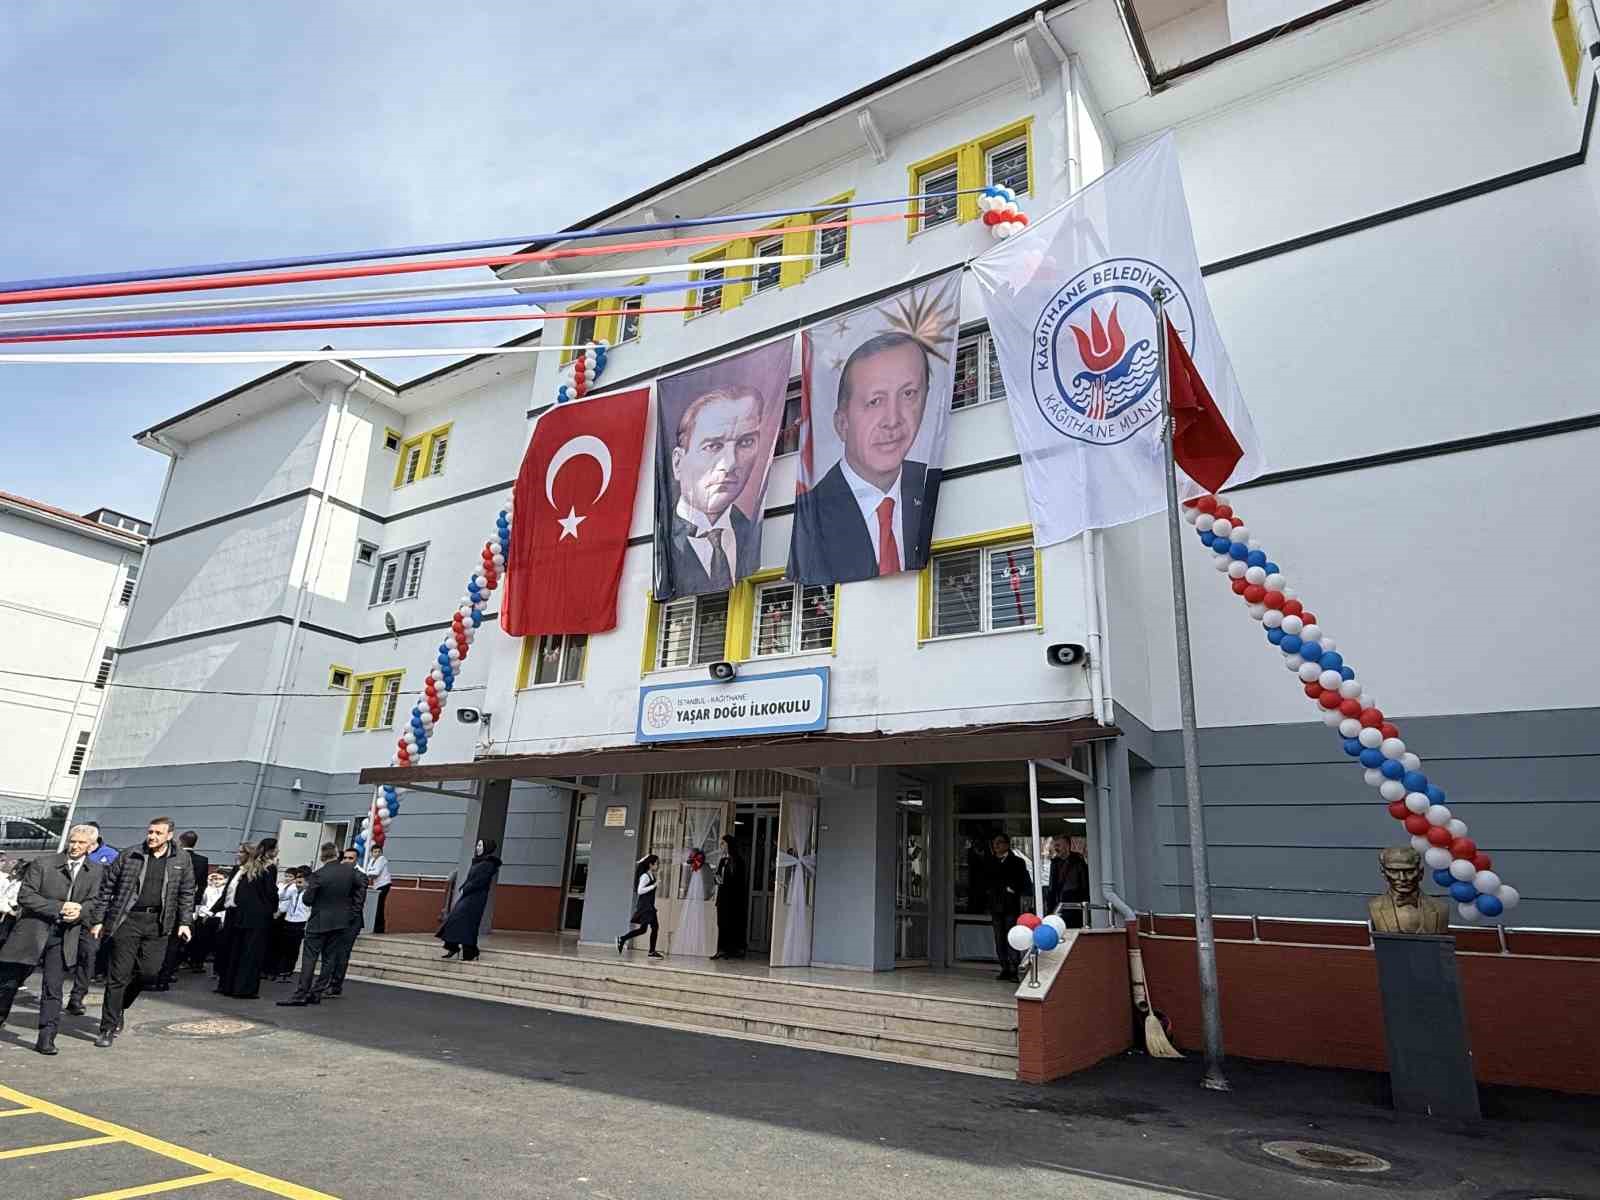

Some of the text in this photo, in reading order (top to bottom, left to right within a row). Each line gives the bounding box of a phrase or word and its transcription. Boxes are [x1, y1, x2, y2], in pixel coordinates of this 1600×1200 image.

[676, 708, 710, 725] YAŞAR
[714, 703, 746, 719] DOĞU
[750, 700, 811, 717] İLKOKULU
